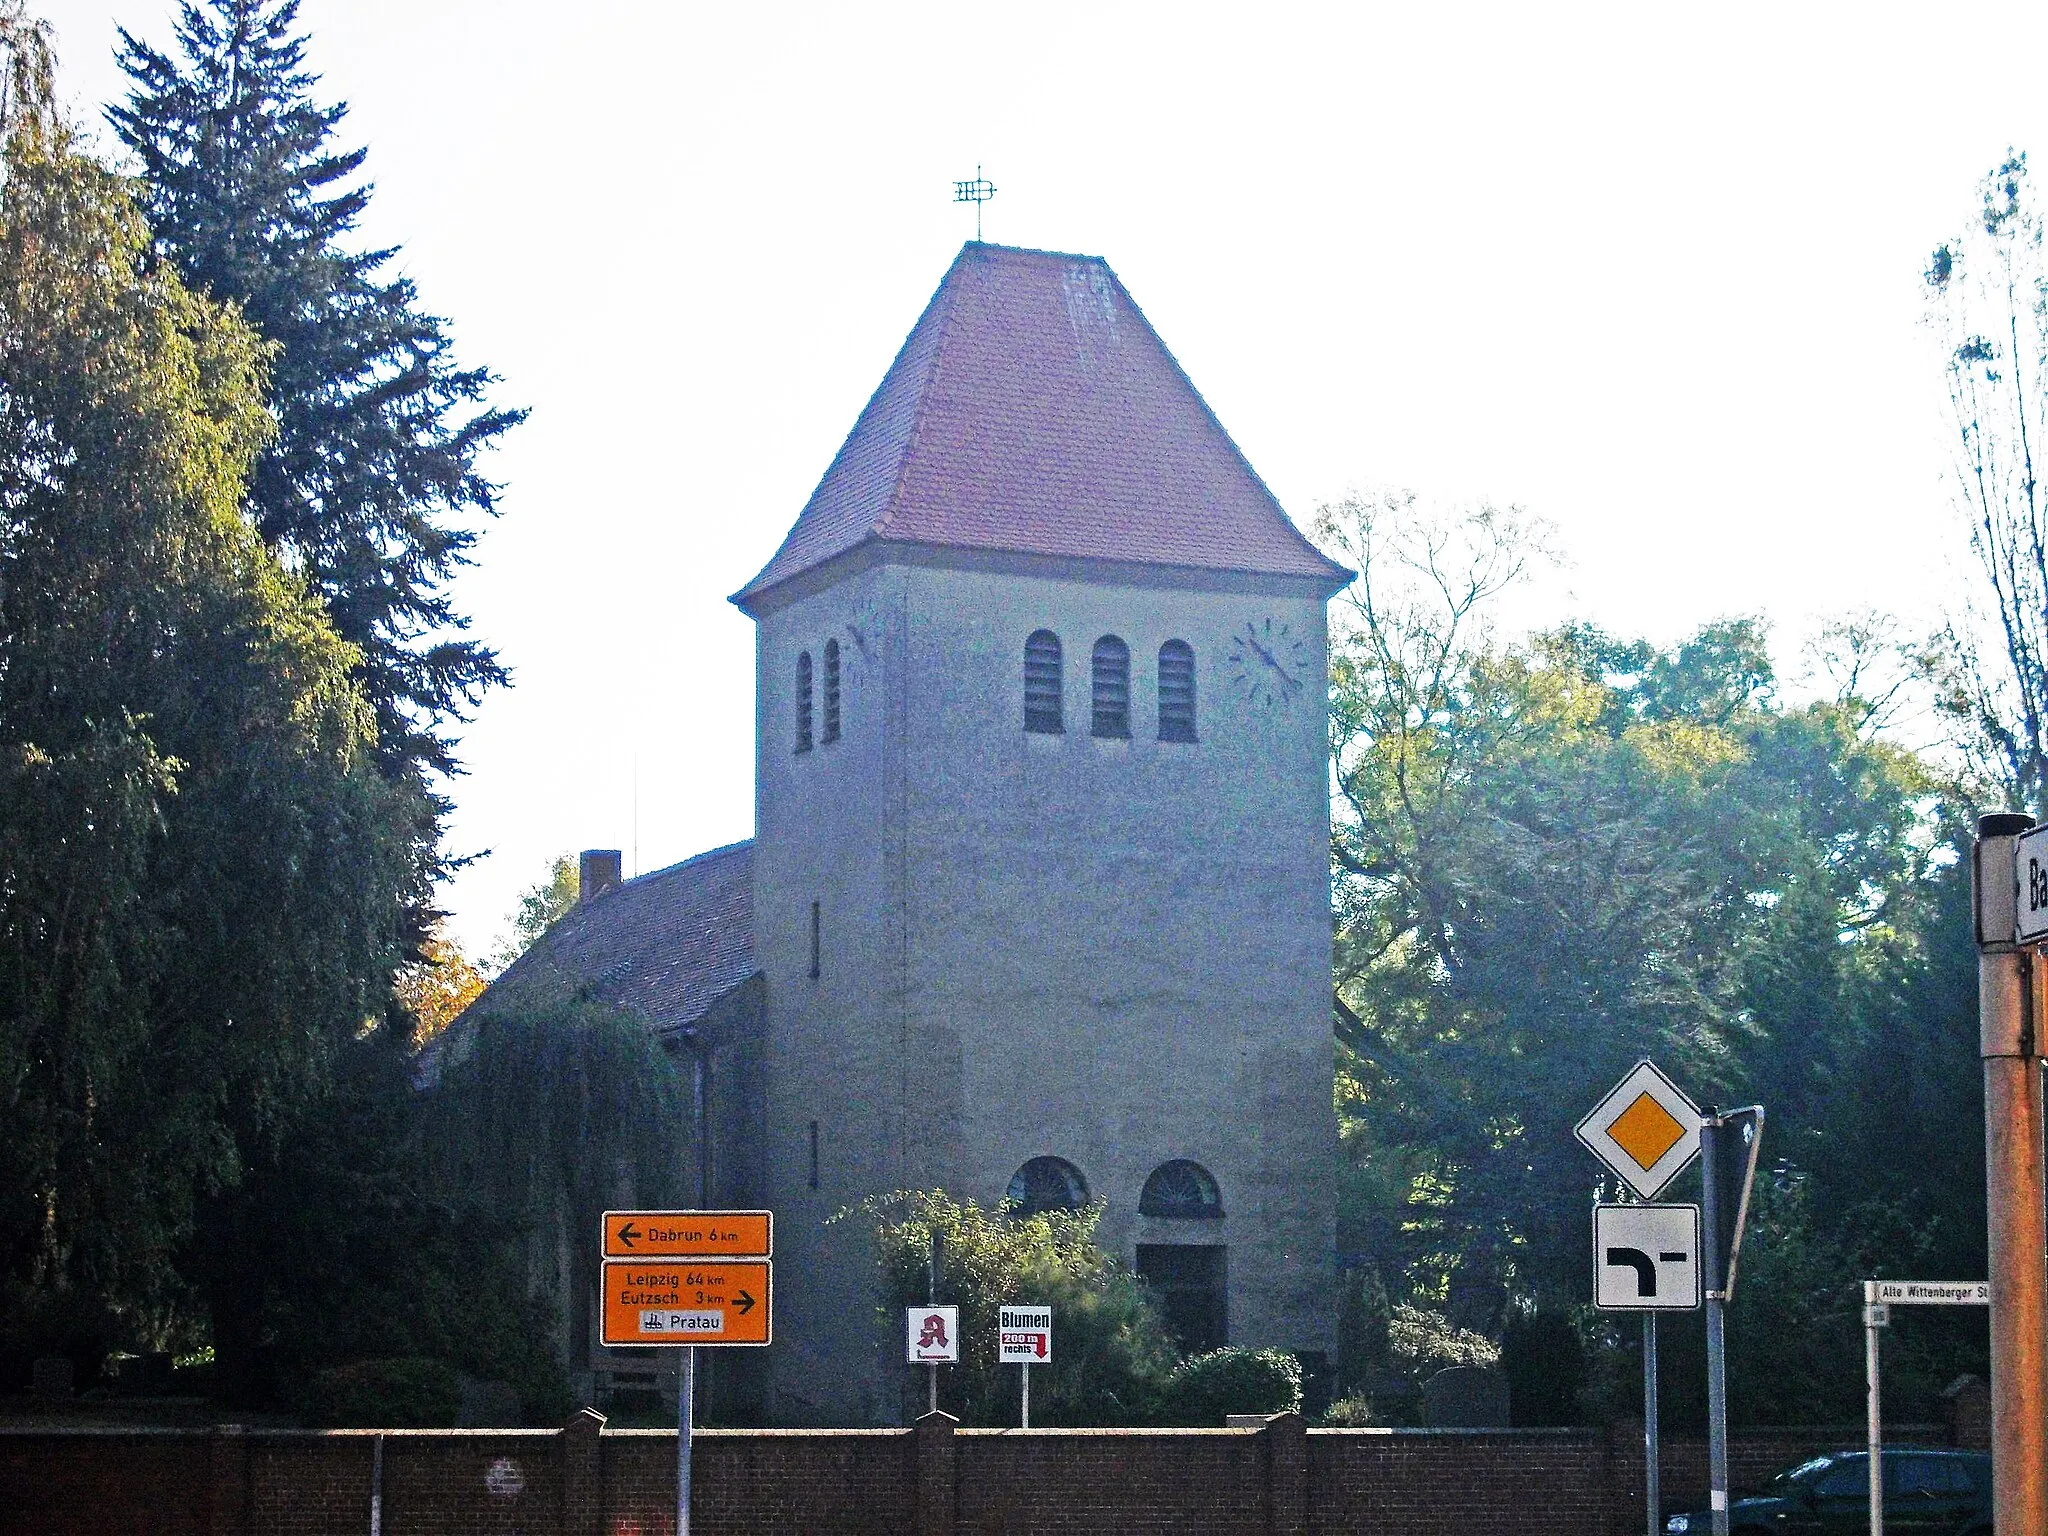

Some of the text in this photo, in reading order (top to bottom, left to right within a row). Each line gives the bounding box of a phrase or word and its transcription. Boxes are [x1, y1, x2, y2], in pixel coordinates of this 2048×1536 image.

[649, 1228, 738, 1242] Dabrun 6 km
[627, 1273, 725, 1288] Leipzig 64 km
[621, 1291, 725, 1305] Eutzsch 3 km
[1883, 1286, 1902, 1298] Alte
[1907, 1285, 1972, 1300] Wittenberger
[670, 1315, 719, 1329] Pratau
[1002, 1312, 1049, 1328] Blumen
[1004, 1334, 1038, 1343] 200 m
[1004, 1344, 1031, 1354] rechts
